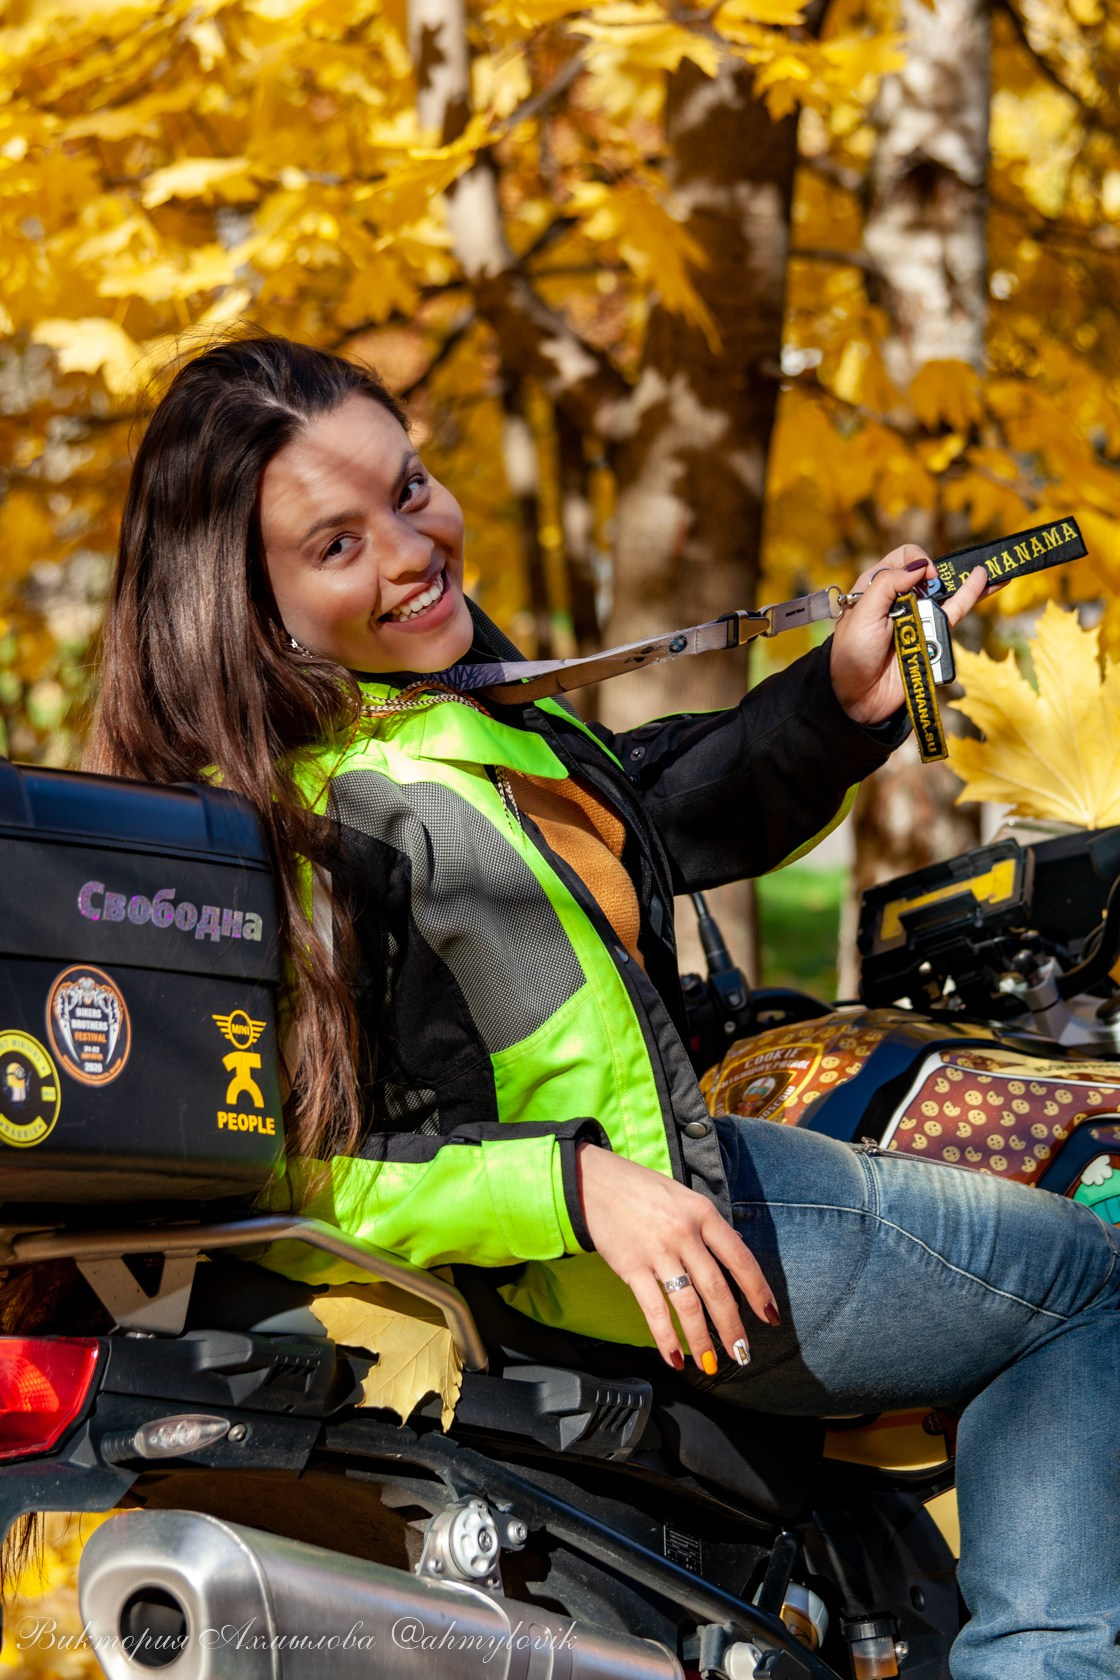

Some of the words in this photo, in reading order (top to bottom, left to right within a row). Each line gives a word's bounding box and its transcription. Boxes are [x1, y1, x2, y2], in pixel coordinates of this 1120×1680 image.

[958, 522, 1079, 584] NANAMA
[77, 880, 263, 942] Свободна
[75, 1007, 102, 1019] BIKERS
[71, 1019, 108, 1032] BROTHERS
[231, 1024, 250, 1036] MINI
[74, 1031, 107, 1043] FESTIVAL
[744, 1047, 799, 1069] COOKIE
[84, 1062, 103, 1073] 2020
[217, 1111, 275, 1135] PEOPLE
